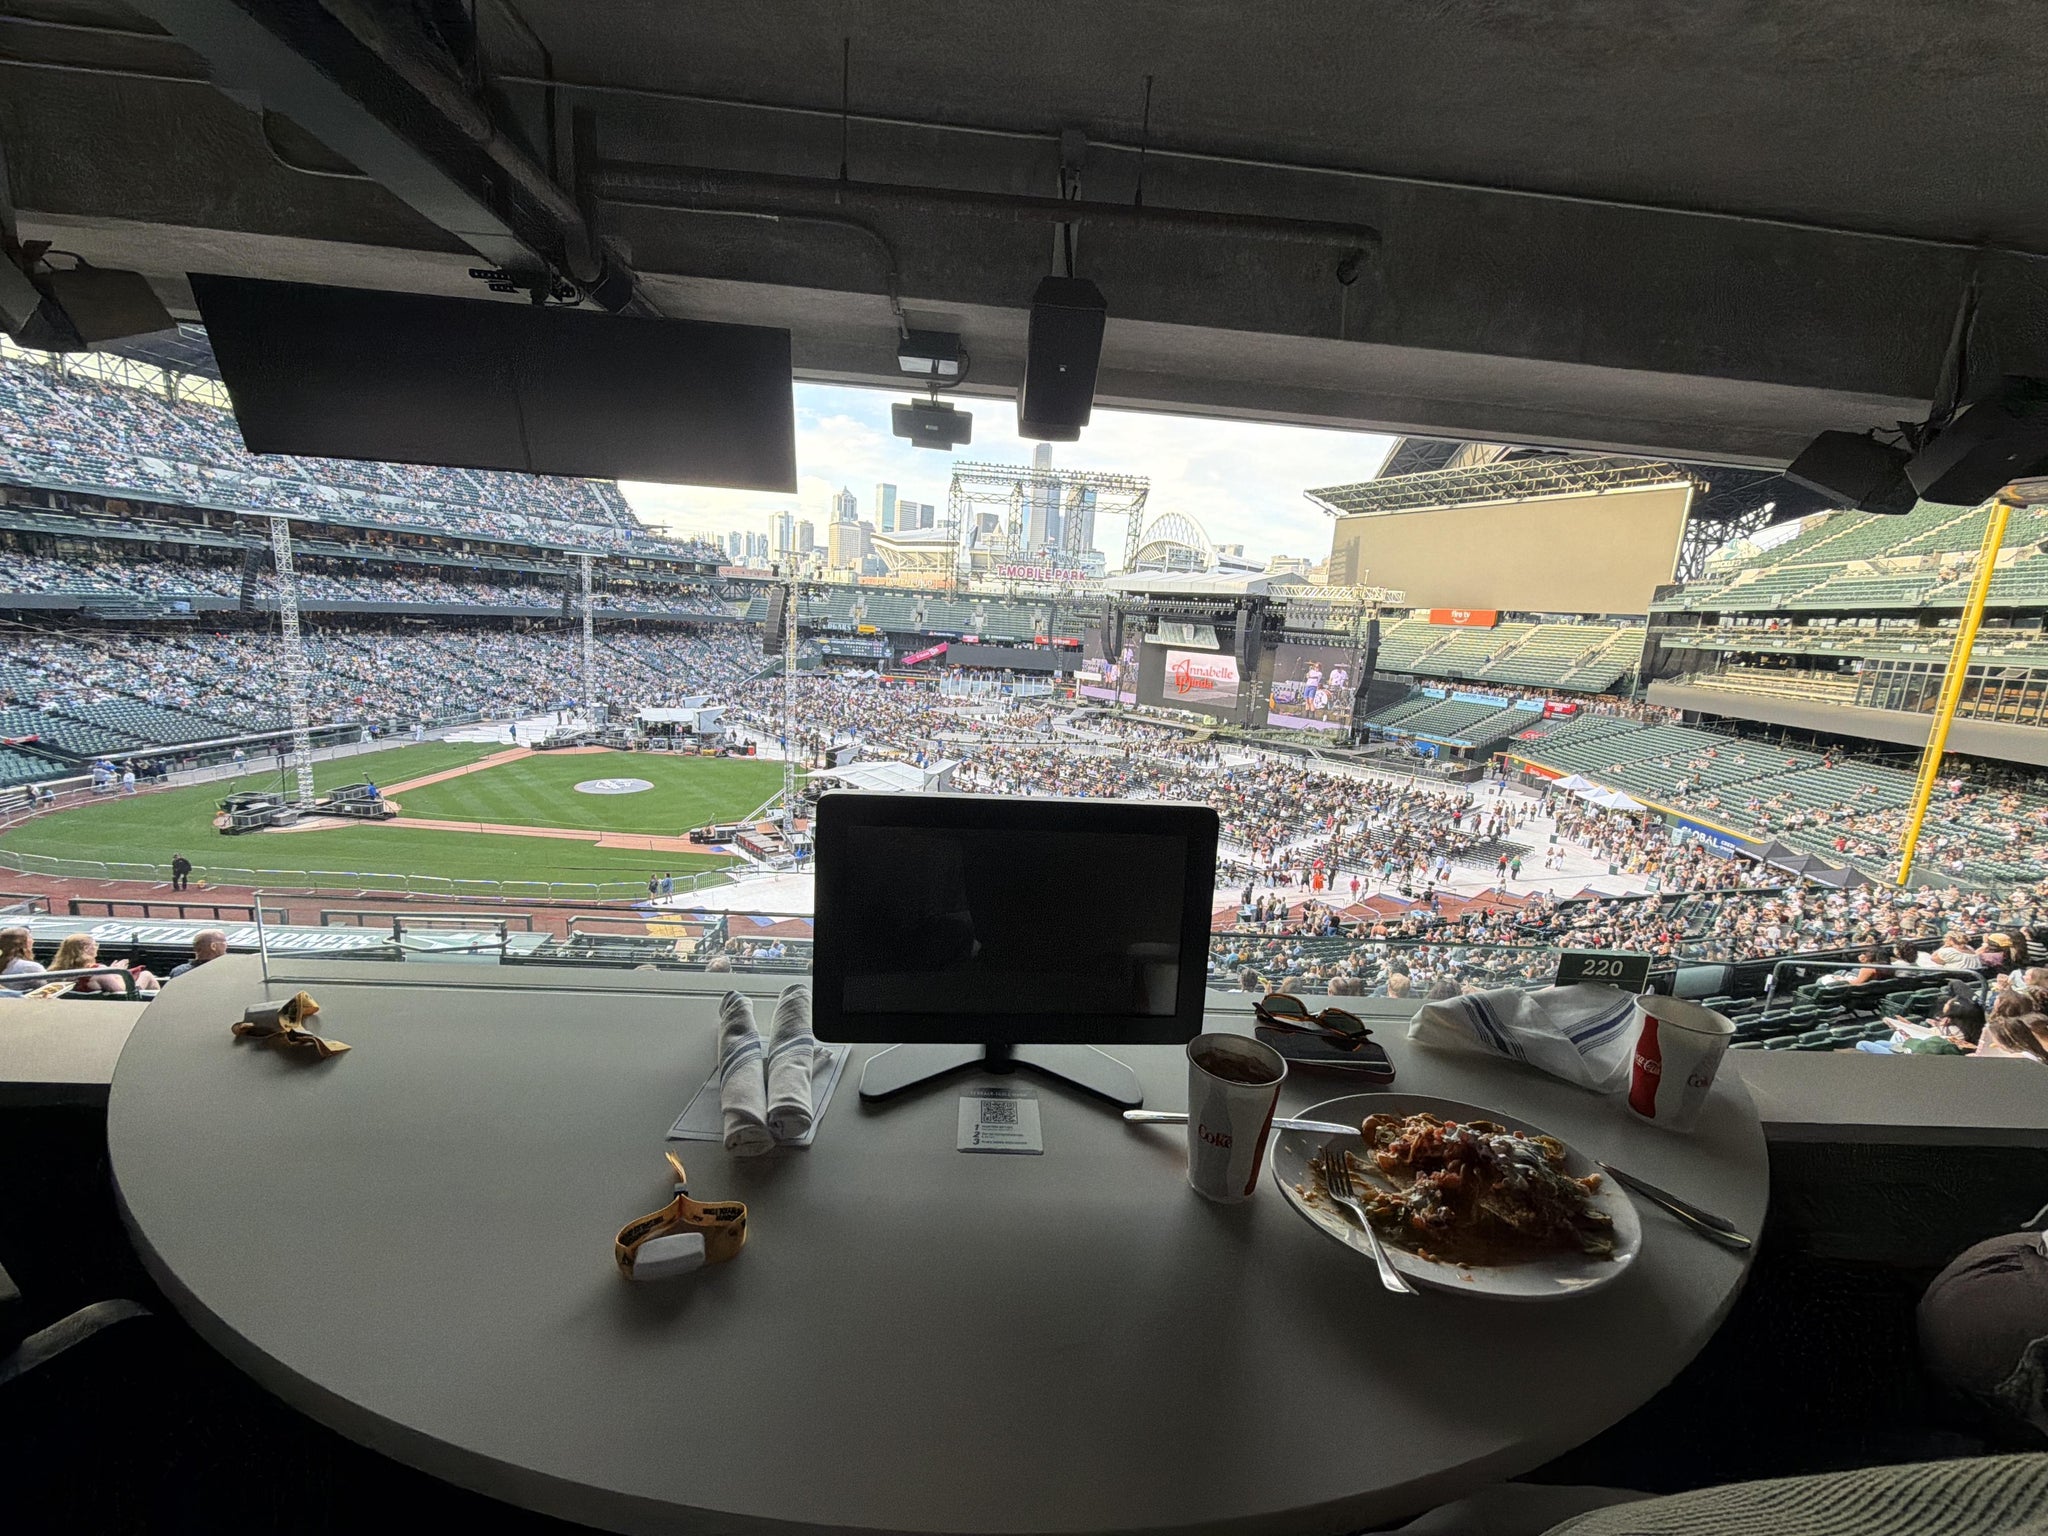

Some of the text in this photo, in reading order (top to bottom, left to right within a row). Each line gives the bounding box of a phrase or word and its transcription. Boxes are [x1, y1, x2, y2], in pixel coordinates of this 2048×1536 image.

[997, 565, 1086, 580] T-MOBILE PARK
[1171, 659, 1233, 679] Annabelle
[89, 922, 379, 949] SEATTL MARINERS
[1582, 959, 1624, 977] 220
[1199, 1123, 1233, 1149] Coke
